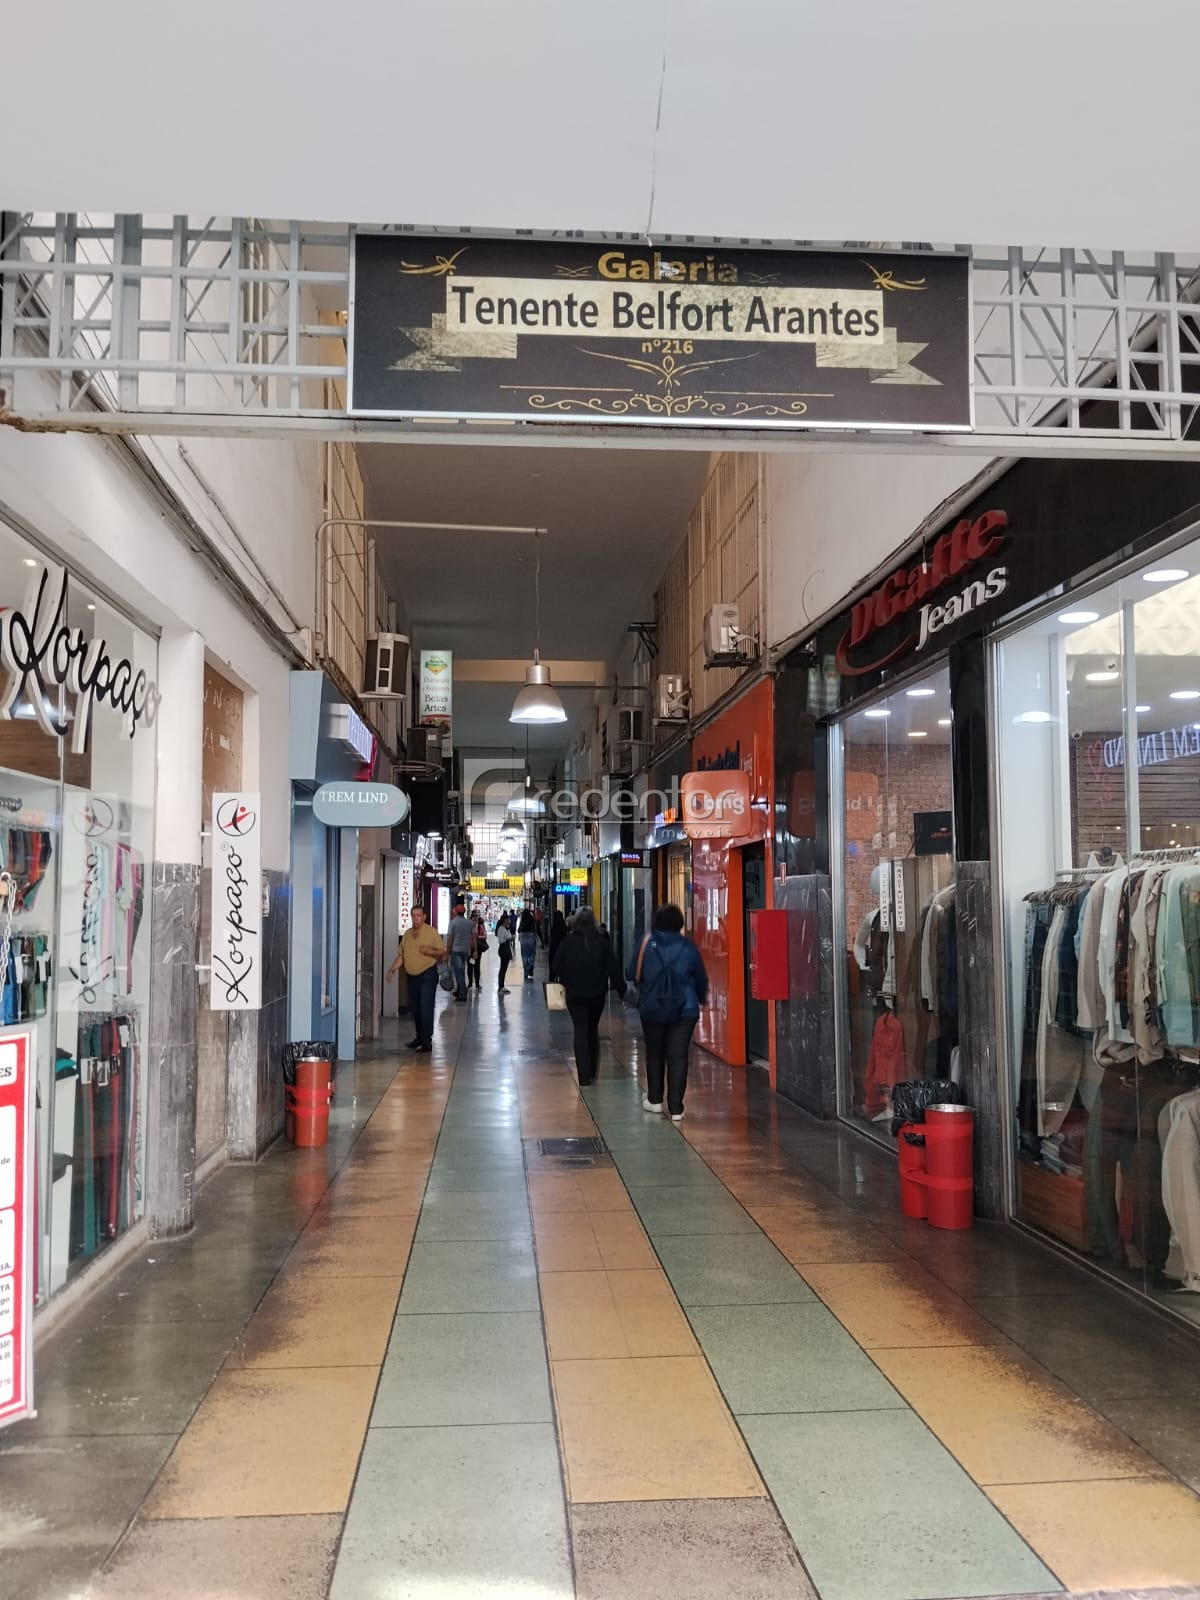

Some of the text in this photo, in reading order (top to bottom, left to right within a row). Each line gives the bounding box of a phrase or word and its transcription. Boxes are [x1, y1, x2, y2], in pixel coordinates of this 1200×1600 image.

[598, 251, 739, 282] Galeria
[452, 285, 881, 337] Tenente Belfort Arantes
[915, 566, 1007, 651] Jeans
[2, 567, 161, 754] Korpaço
[320, 790, 389, 804] TREM LIND
[212, 844, 258, 1004] Korpaço
